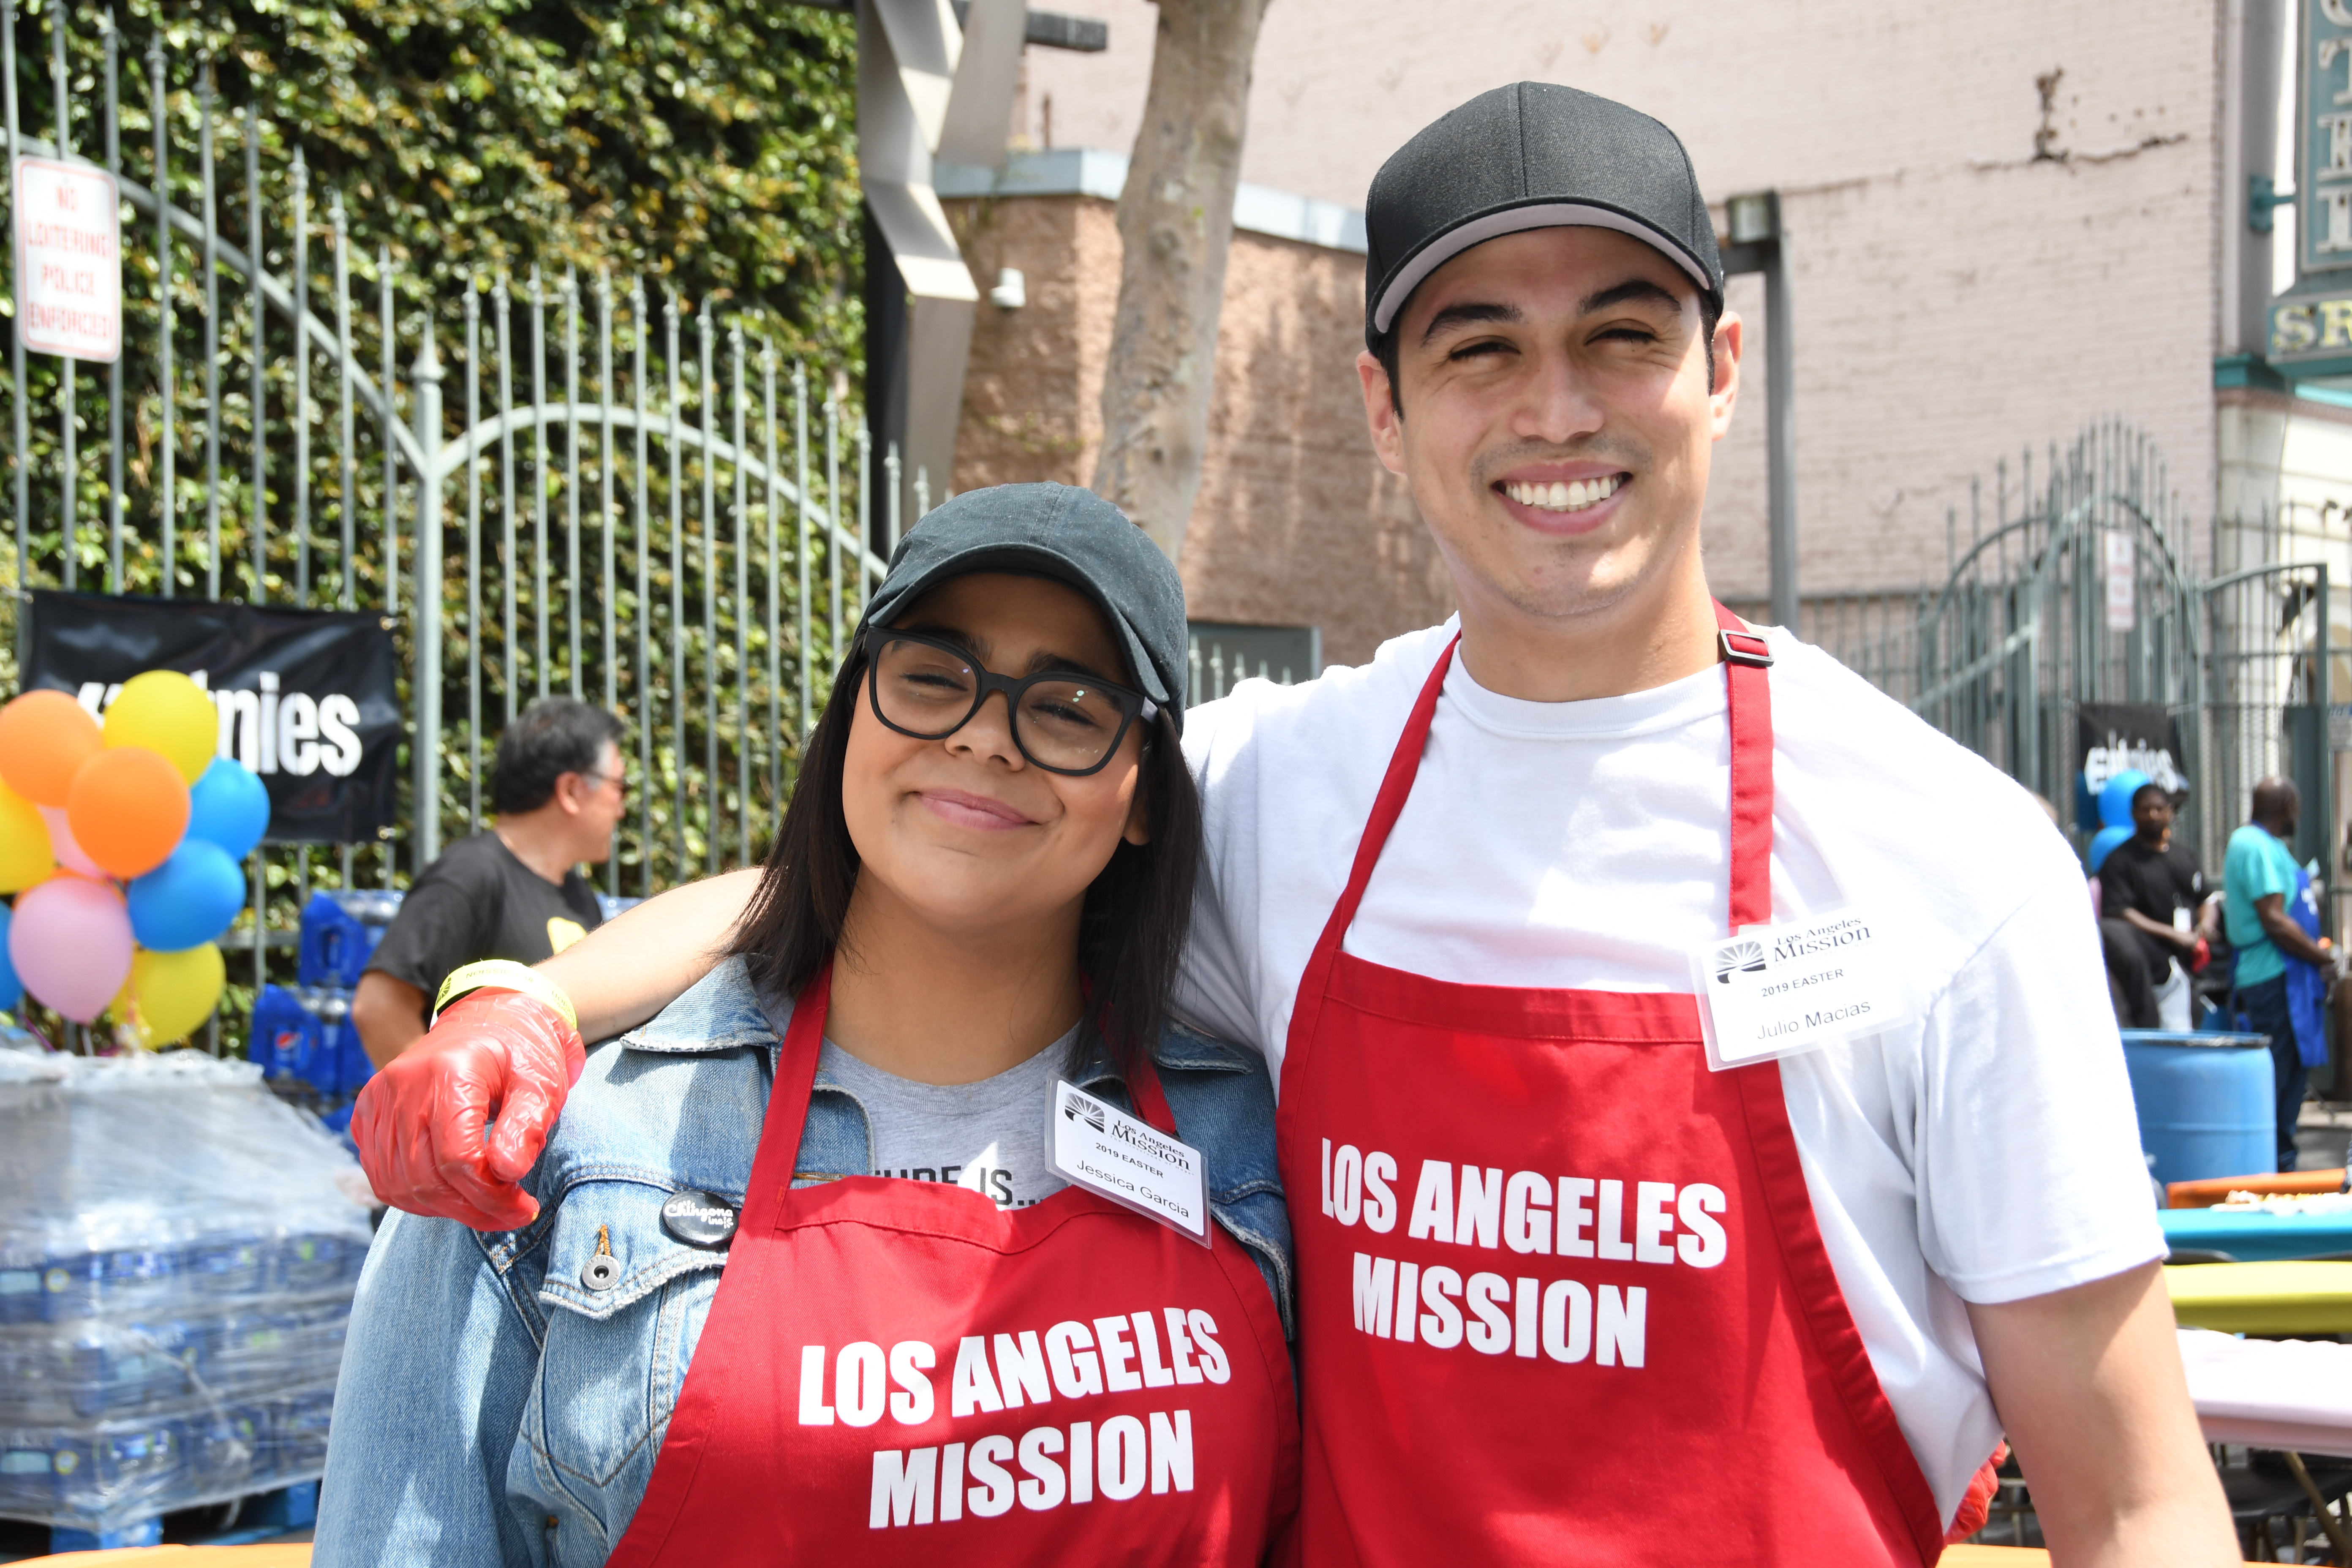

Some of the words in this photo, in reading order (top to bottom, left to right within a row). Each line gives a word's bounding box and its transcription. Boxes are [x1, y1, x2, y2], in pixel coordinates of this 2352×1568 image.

[56, 186, 78, 211] NO
[27, 221, 112, 258] LOITERING
[42, 264, 95, 297] POLICE
[28, 301, 113, 339] ENFORCED
[1777, 934, 1801, 945] Los
[1807, 918, 1861, 938] Angeles
[1761, 983, 1789, 997] 2019
[1792, 969, 1844, 989] EASTER
[1757, 1020, 1799, 1040] Julio
[1805, 1002, 1870, 1028] Macias
[1118, 1120, 1137, 1134] Los
[1139, 1132, 1184, 1157] Angeles
[1095, 1143, 1119, 1158] 2019
[1122, 1154, 1164, 1179] EASTER
[1077, 1160, 1135, 1192] Jessica
[1140, 1186, 1190, 1218] Garcia
[1322, 1137, 1398, 1233] LOS
[1408, 1159, 1727, 1269] ANGELES
[664, 1200, 733, 1222] Chingona
[1352, 1251, 1647, 1368] MISSION
[798, 1341, 936, 1427] LOS
[952, 1307, 1231, 1418] ANGELES
[869, 1410, 1194, 1529] MISSION
